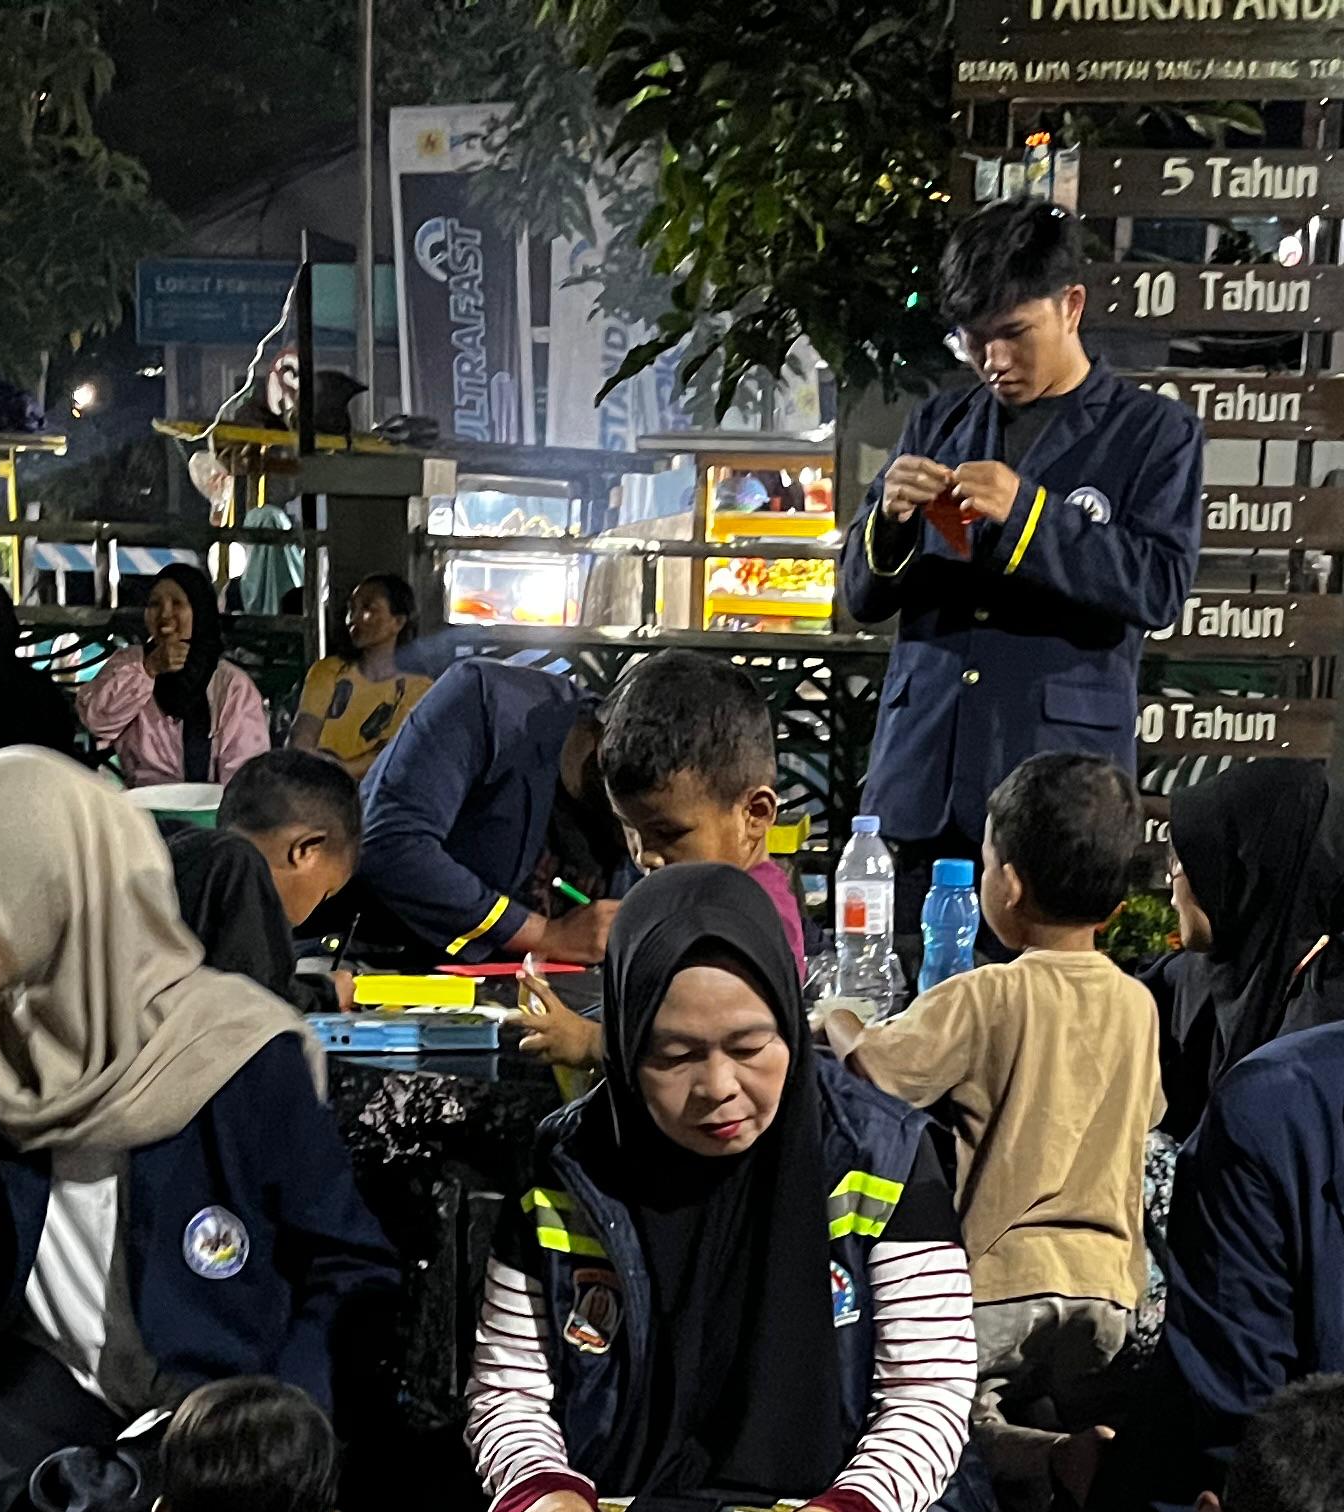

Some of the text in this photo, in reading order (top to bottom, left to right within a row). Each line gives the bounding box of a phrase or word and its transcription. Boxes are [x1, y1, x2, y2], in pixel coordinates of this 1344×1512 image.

[1161, 157, 1195, 196] 5
[1205, 156, 1320, 199] Tahun
[1133, 271, 1176, 318] 10
[1199, 269, 1312, 314] Tahun
[448, 217, 490, 442] ULTRAFAST
[1189, 383, 1302, 422] Tahun
[1201, 492, 1293, 532] ahun
[1181, 597, 1284, 639] Tahun
[1170, 703, 1277, 742] Tahun
